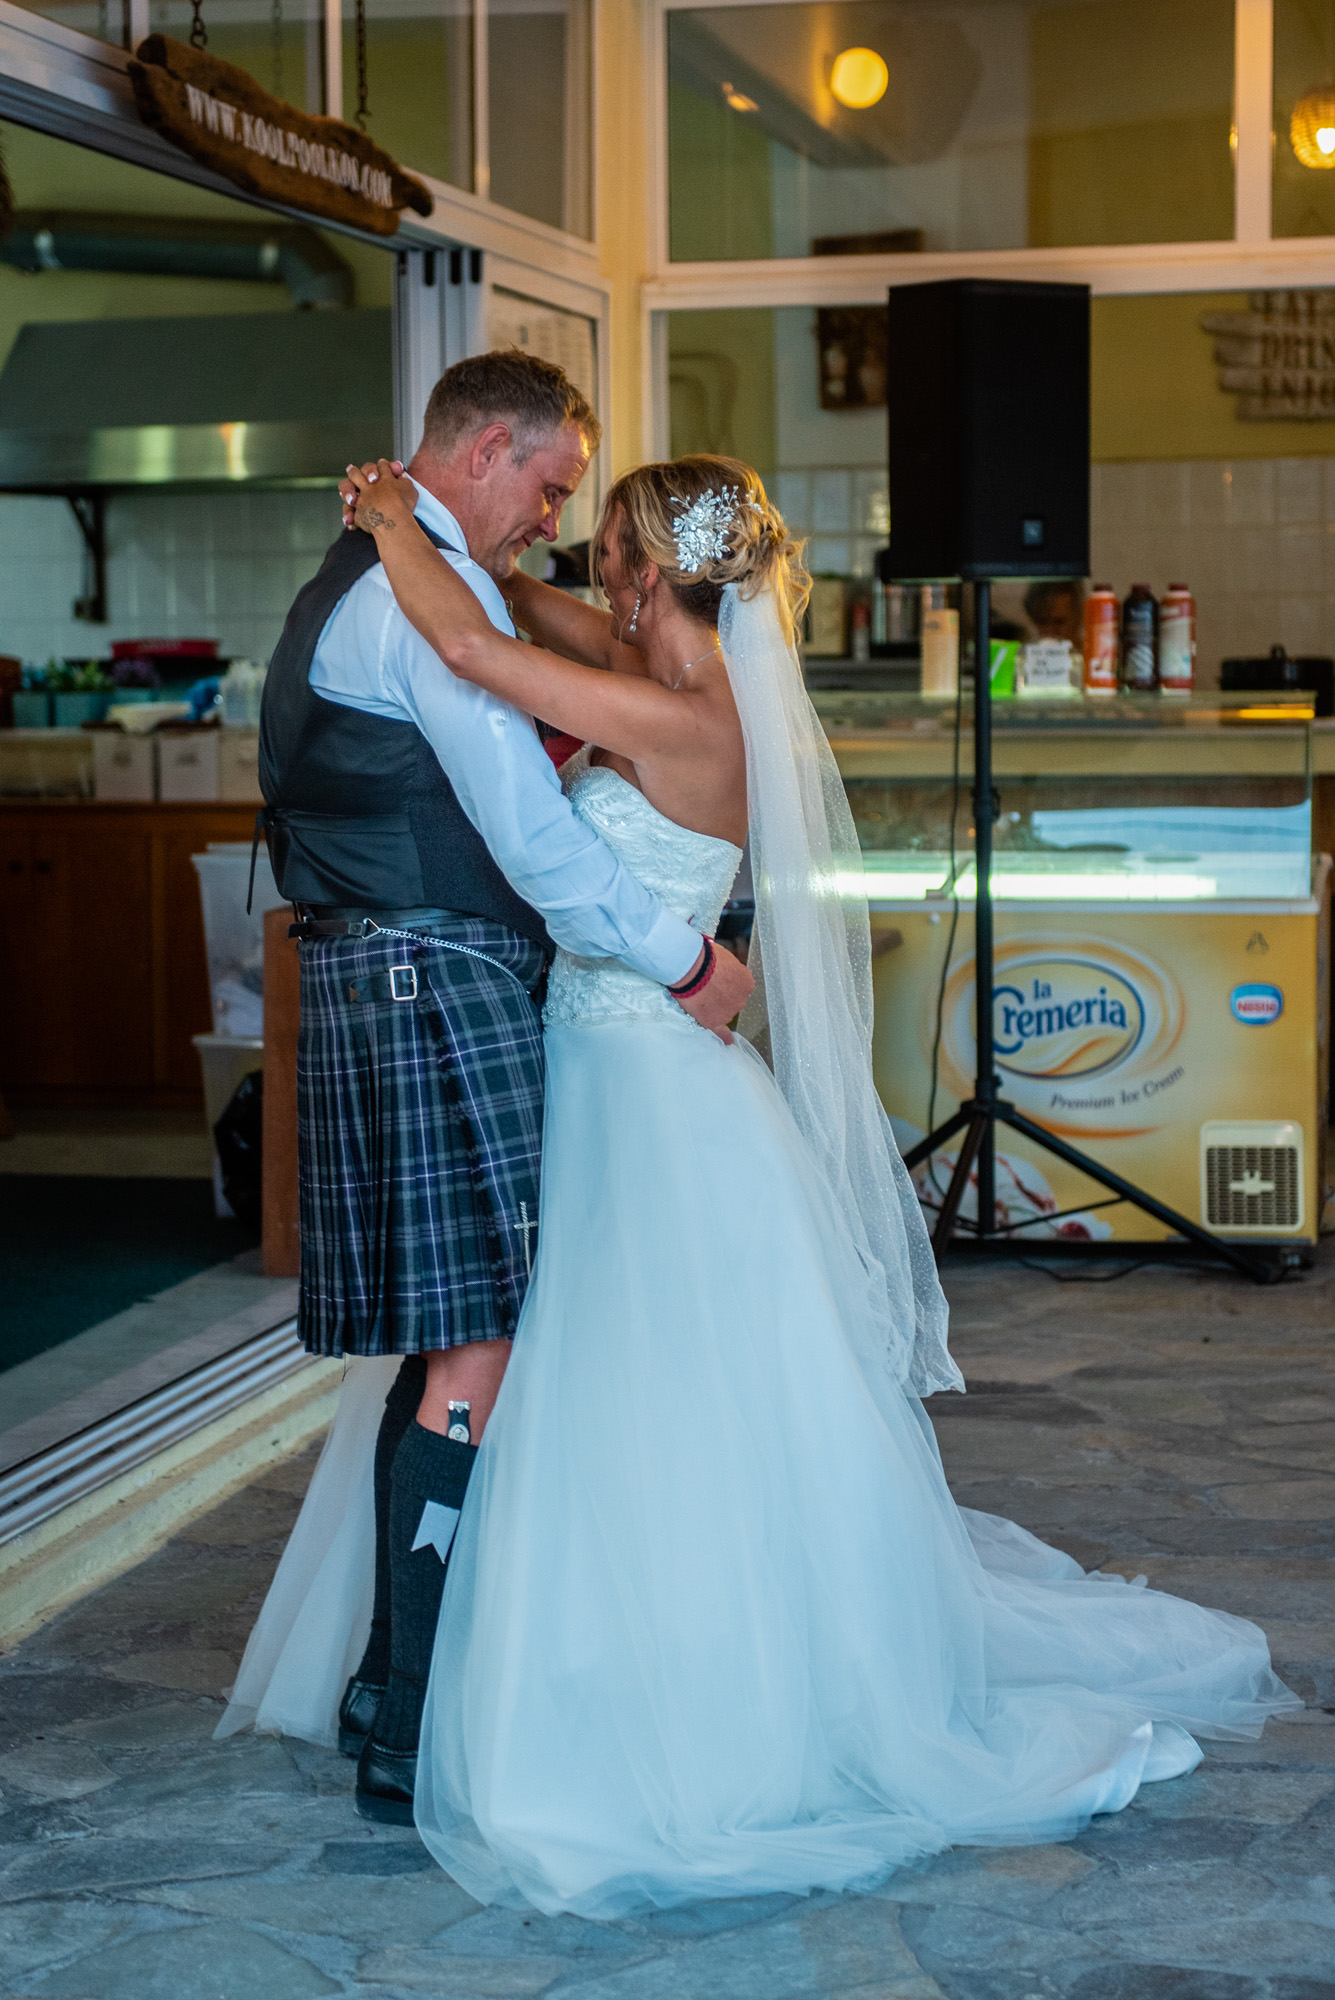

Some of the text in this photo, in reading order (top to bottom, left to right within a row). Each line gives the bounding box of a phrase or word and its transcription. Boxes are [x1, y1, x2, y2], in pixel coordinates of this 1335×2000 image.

[1033, 978, 1053, 1000] la
[992, 985, 1128, 1055] Cremeria
[1050, 1065, 1185, 1109] Premium Ice Cream
